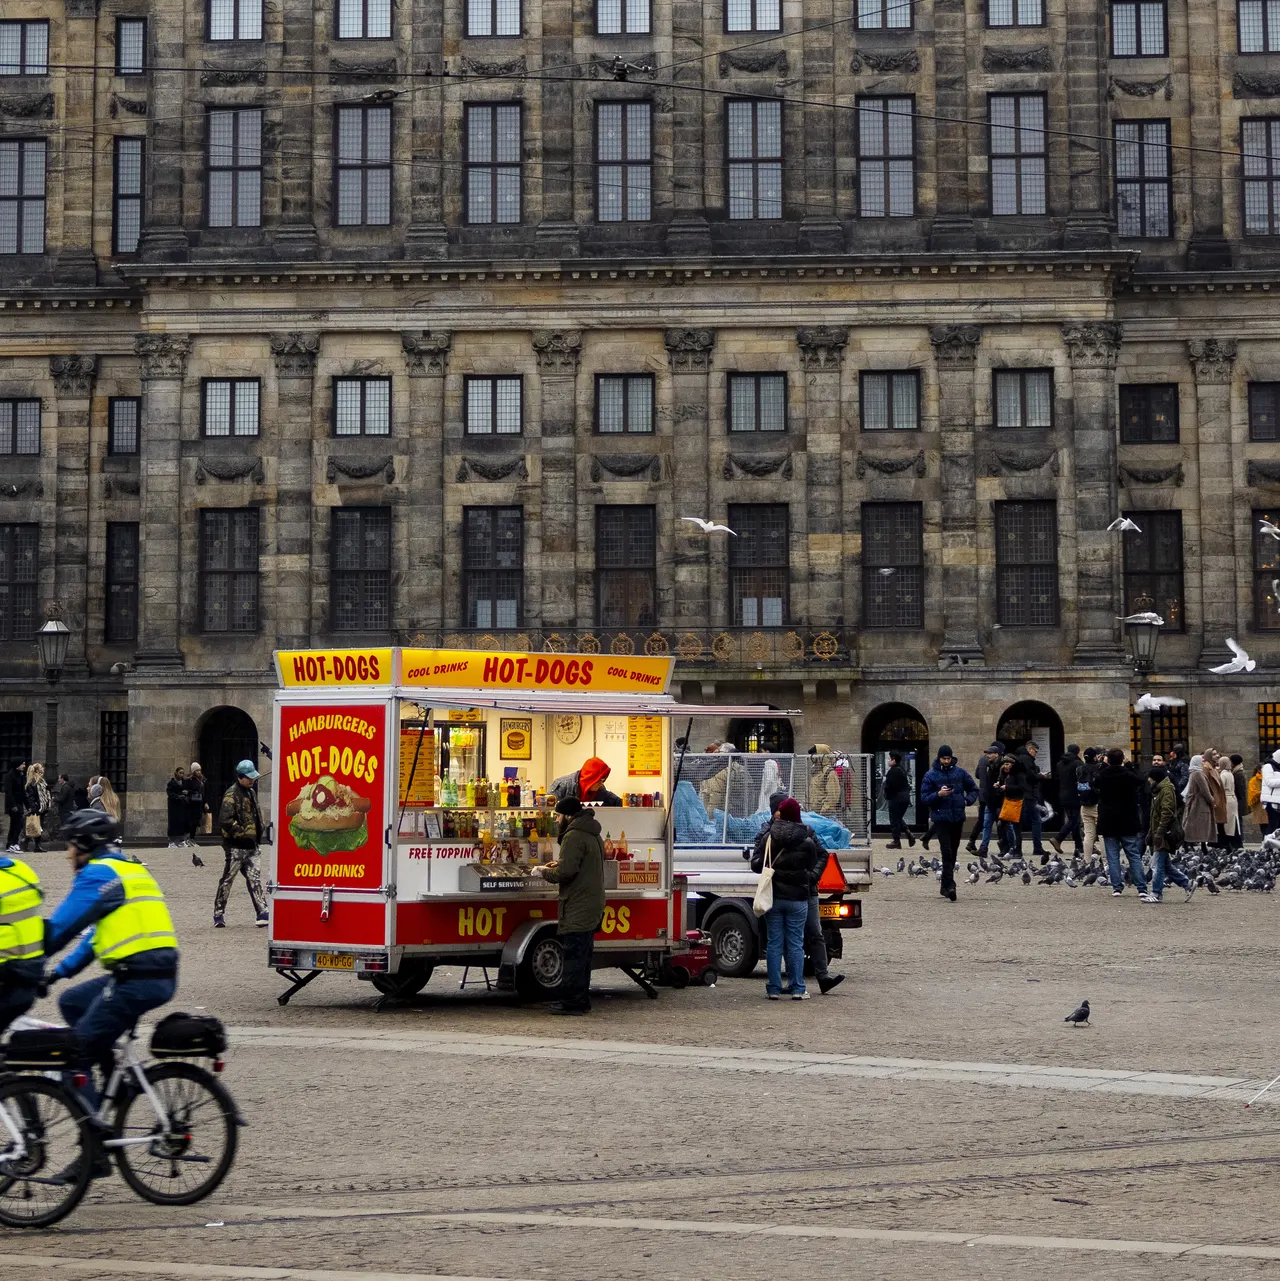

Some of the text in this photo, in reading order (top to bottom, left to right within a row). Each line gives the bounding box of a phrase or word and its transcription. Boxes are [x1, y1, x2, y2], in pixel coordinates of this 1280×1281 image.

[293, 655, 380, 682] HOT-DOGS
[407, 660, 469, 679] COOL DRINKS
[483, 656, 594, 685] HOT-DOGS
[607, 666, 662, 685] COOL DRINKS
[288, 714, 377, 742] HAMBURGERS
[286, 745, 378, 783] HOT-DOGS
[408, 847, 432, 859] FREE
[294, 863, 365, 878] COLD DRINKS
[621, 873, 657, 883] TOPPINGS FREE
[482, 881, 497, 889] SELF
[458, 907, 507, 937] HOT
